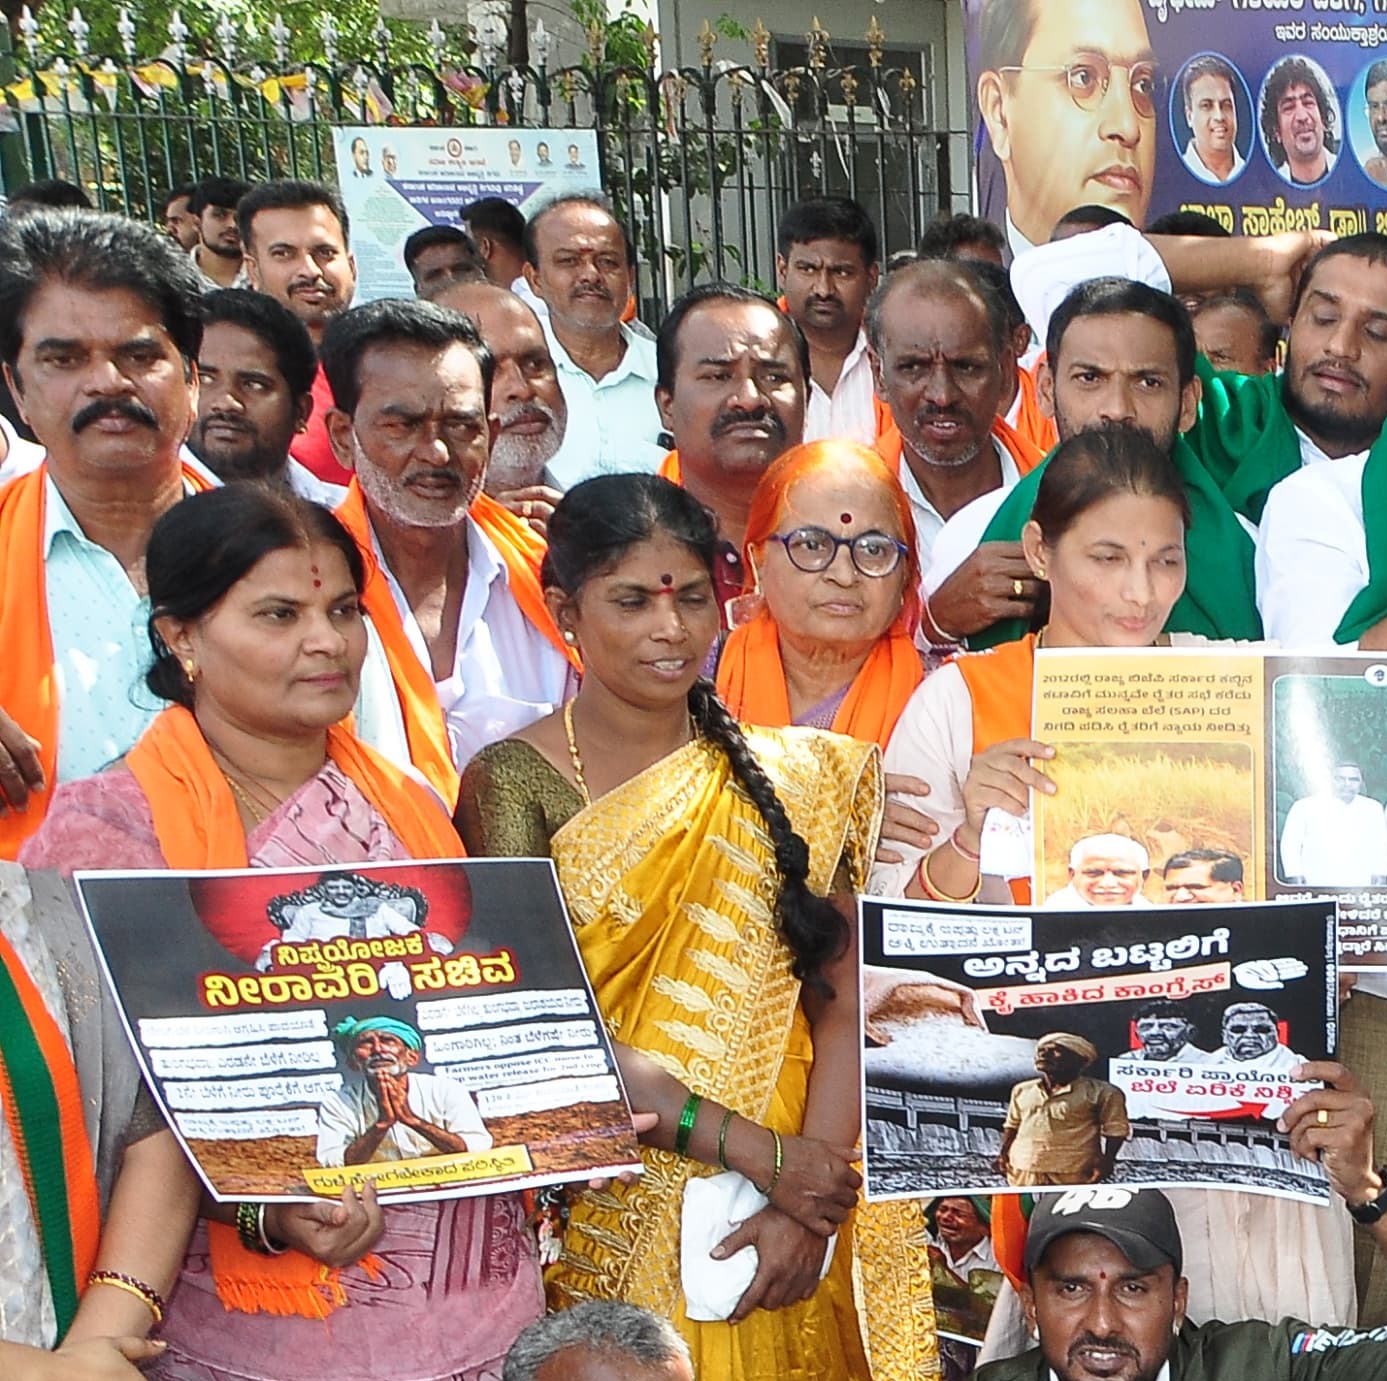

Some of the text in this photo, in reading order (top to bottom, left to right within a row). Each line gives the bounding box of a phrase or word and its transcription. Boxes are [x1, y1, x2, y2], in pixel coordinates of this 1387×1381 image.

[1275, 22, 1306, 41] ಇವರ
[1170, 706, 1205, 716] (SAP)
[963, 928, 1231, 983] ಅನ್ನದ ಬಟ್ಟಲಿಗೆ
[204, 952, 516, 1008] ನೀರಾವರಿ ಸಚಿವ
[990, 973, 1226, 1014] ಕೈ ಹಾಕಿದ ಕಾಂಗ್ರೆಸ್
[494, 1059, 532, 1071] oppose
[1117, 1064, 1193, 1077] ಸರ್ಕಾರಿ
[1131, 1080, 1246, 1097] ಬೆಲೆ ಏರಿಕೆ
